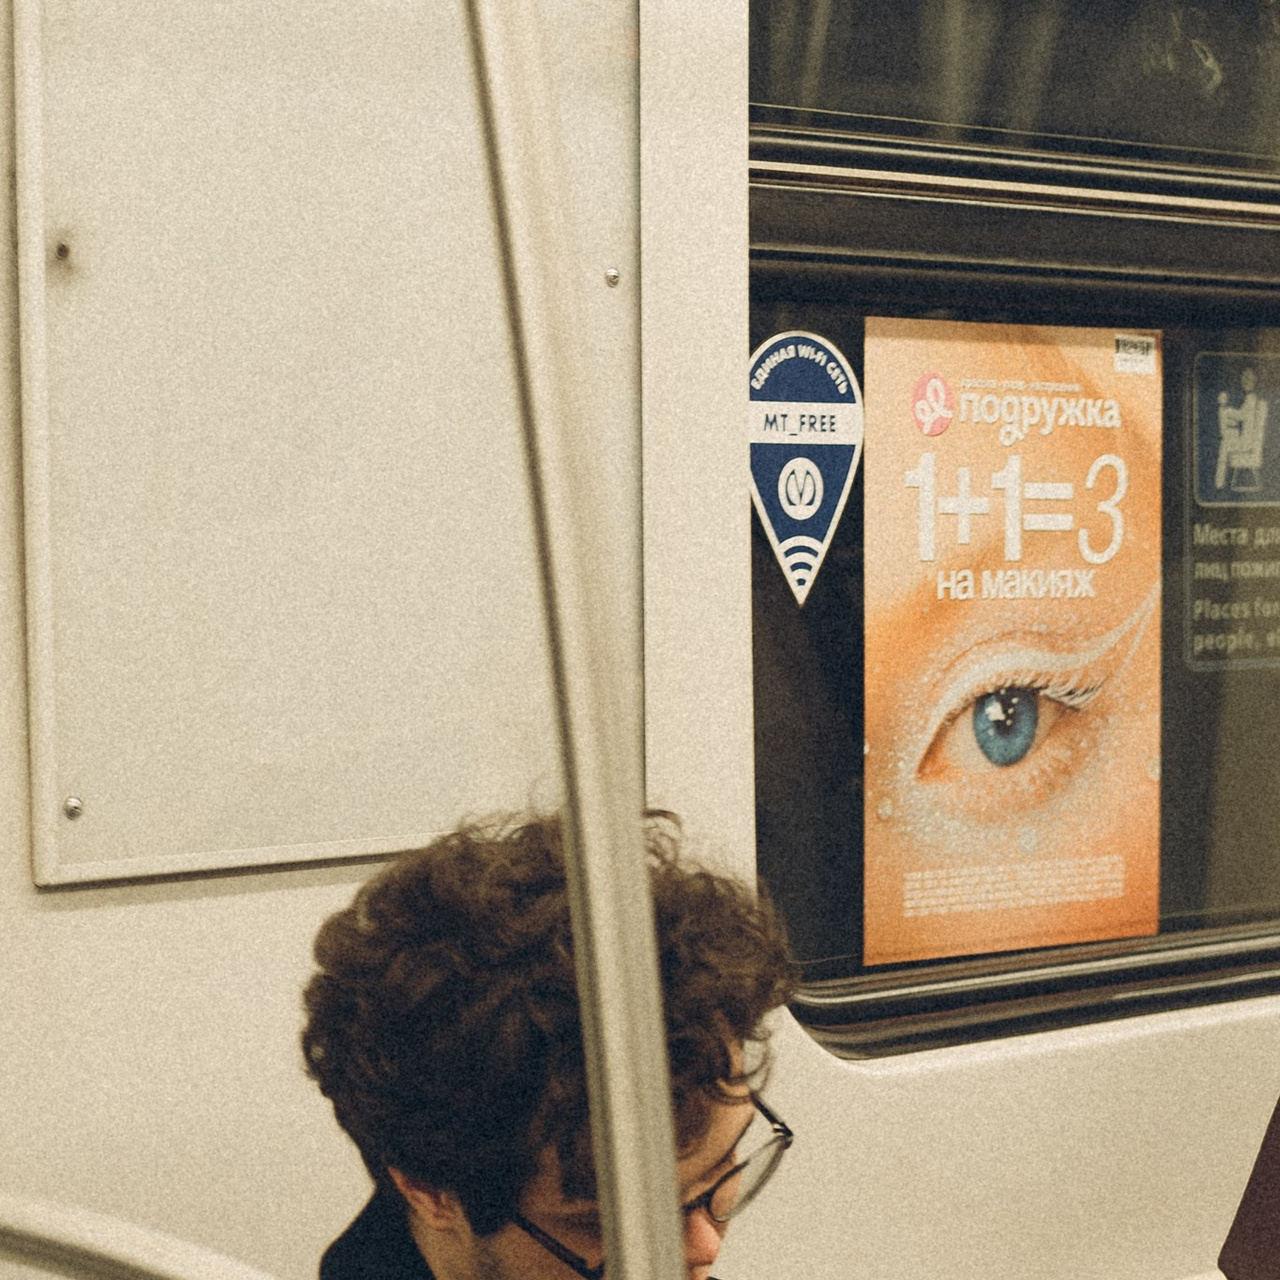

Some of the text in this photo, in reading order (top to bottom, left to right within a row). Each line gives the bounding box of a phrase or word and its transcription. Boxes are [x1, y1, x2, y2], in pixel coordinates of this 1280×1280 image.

[763, 413, 836, 436] MT_FREE
[958, 392, 1123, 446] подружка
[903, 452, 1129, 564] 1+1=3
[1193, 523, 1249, 547] Места
[936, 568, 1097, 600] на макияж
[1193, 599, 1251, 621] Places
